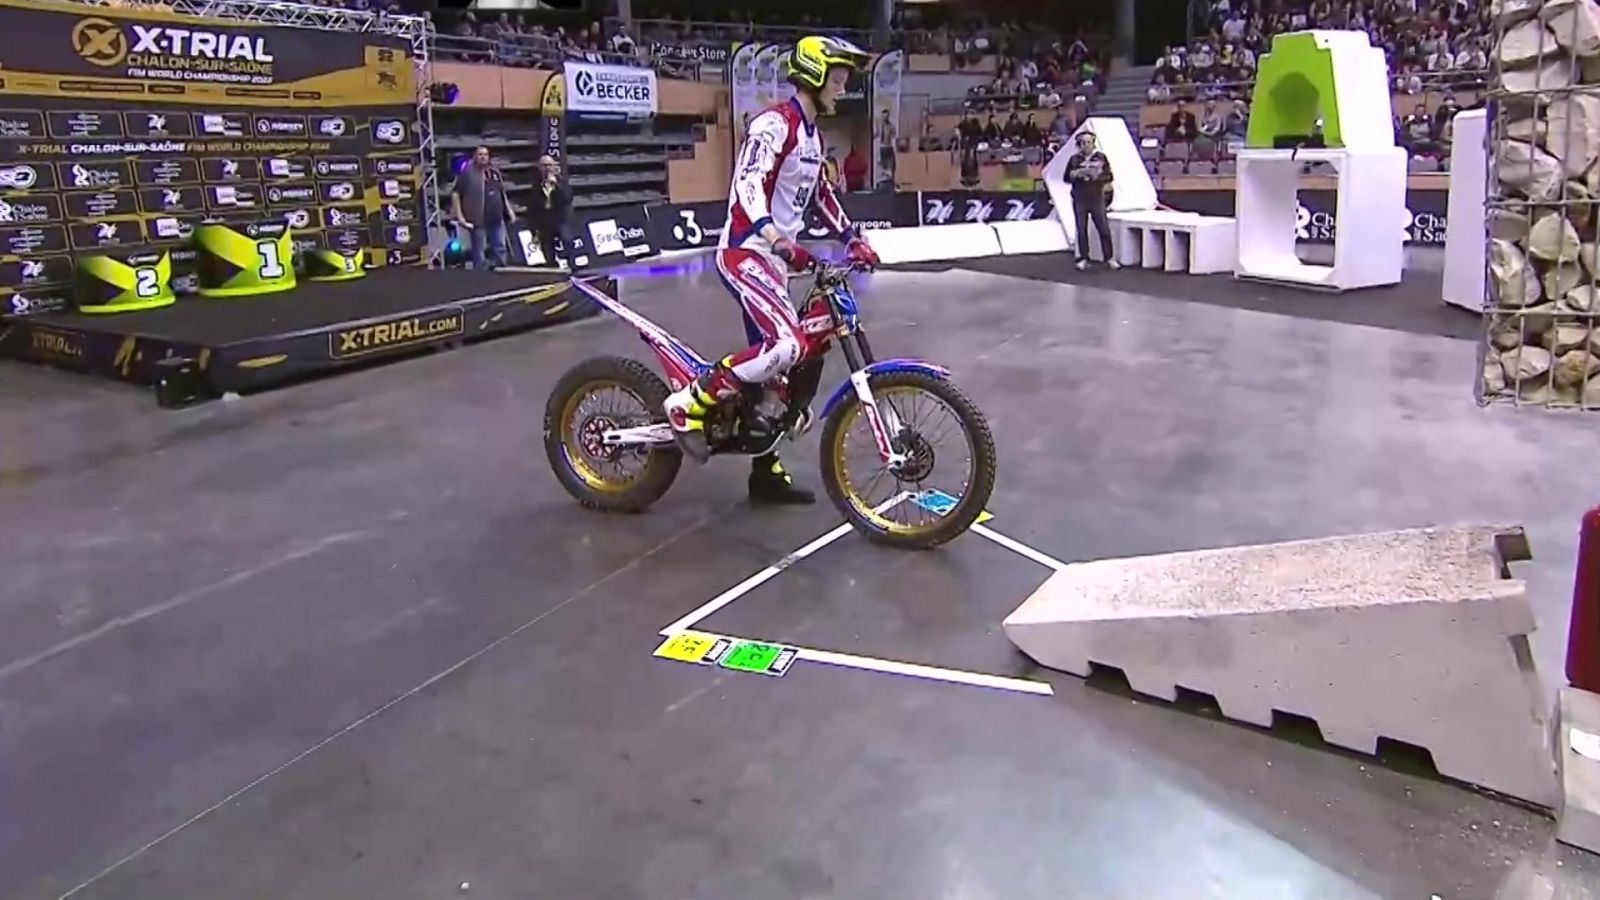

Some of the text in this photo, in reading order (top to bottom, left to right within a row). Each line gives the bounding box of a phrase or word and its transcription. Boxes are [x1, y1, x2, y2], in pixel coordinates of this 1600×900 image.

[147, 69, 183, 80] WORLD
[596, 83, 650, 100] BECKER
[259, 243, 284, 277] 1
[137, 268, 159, 297] 2
